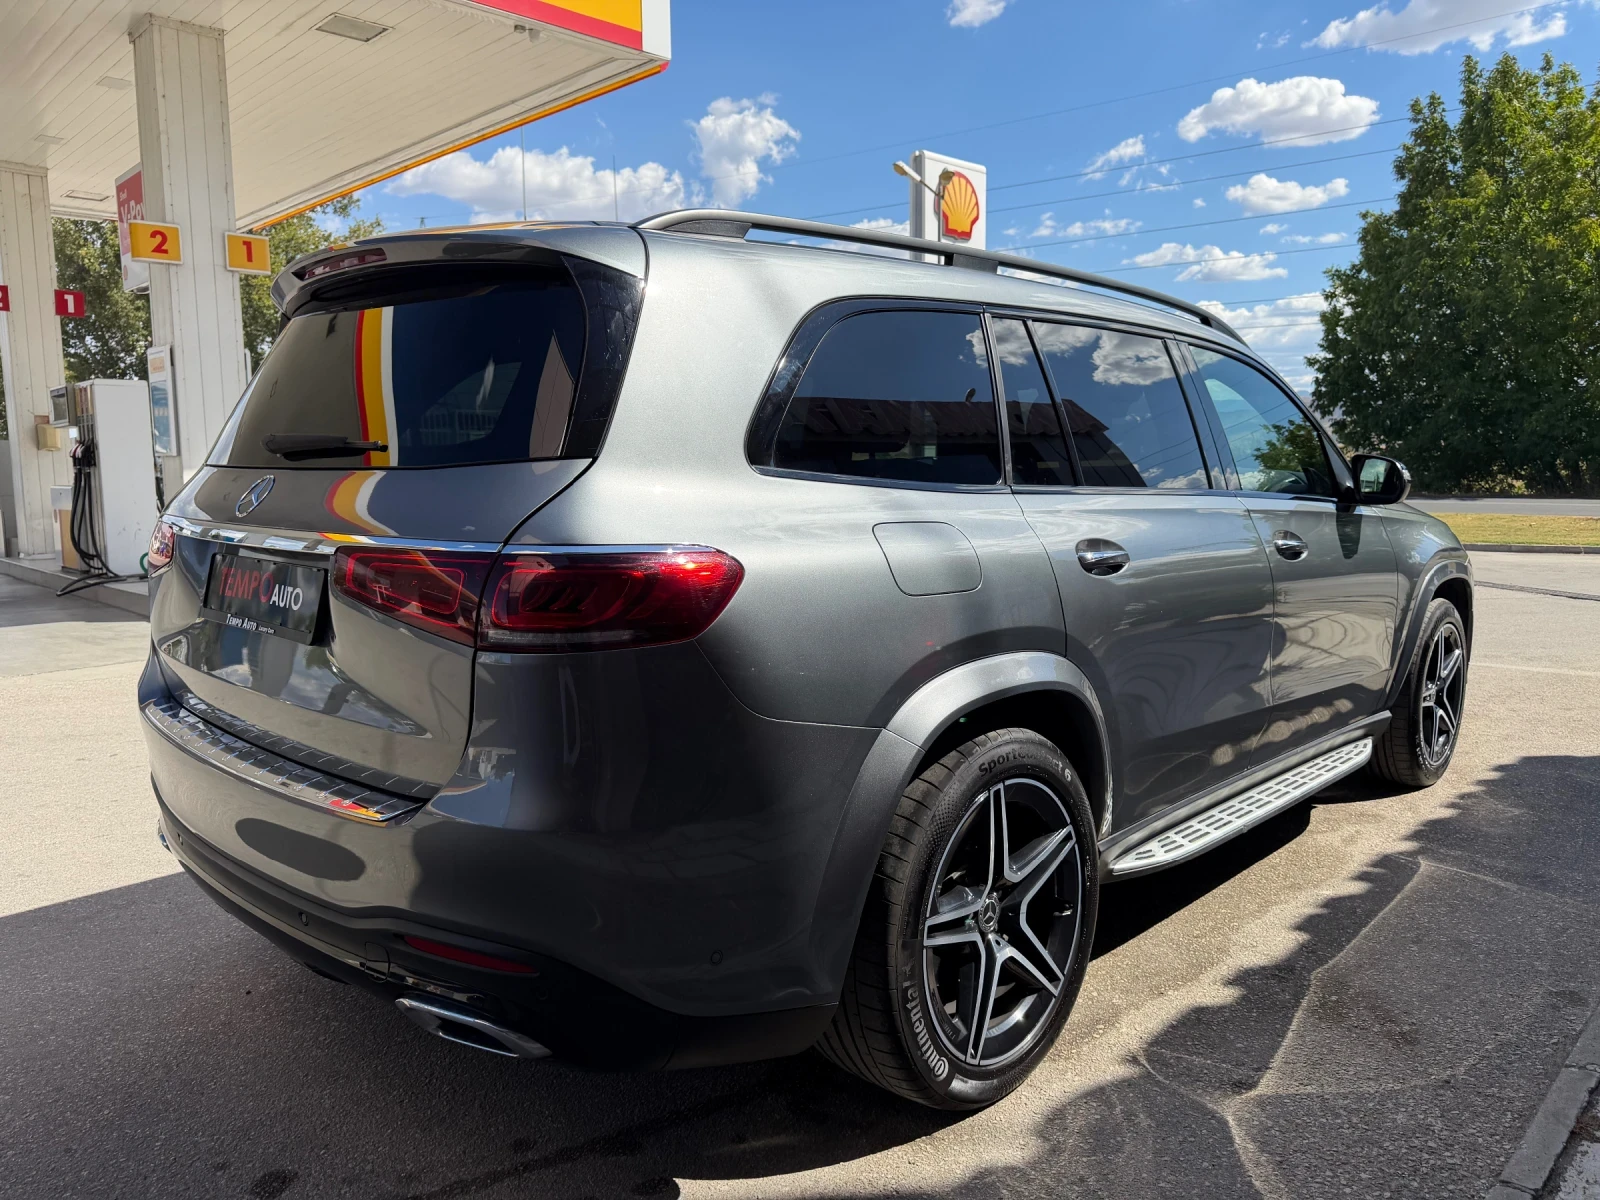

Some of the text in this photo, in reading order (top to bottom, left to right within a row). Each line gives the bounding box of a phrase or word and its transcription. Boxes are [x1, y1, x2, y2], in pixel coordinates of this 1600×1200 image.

[149, 229, 169, 254] 2
[242, 240, 253, 263] 1
[63, 294, 75, 313] 1
[269, 583, 303, 611] AUTO
[978, 746, 1063, 778] SportCct
[1064, 768, 1072, 782] 6
[902, 979, 949, 1082] Continental
